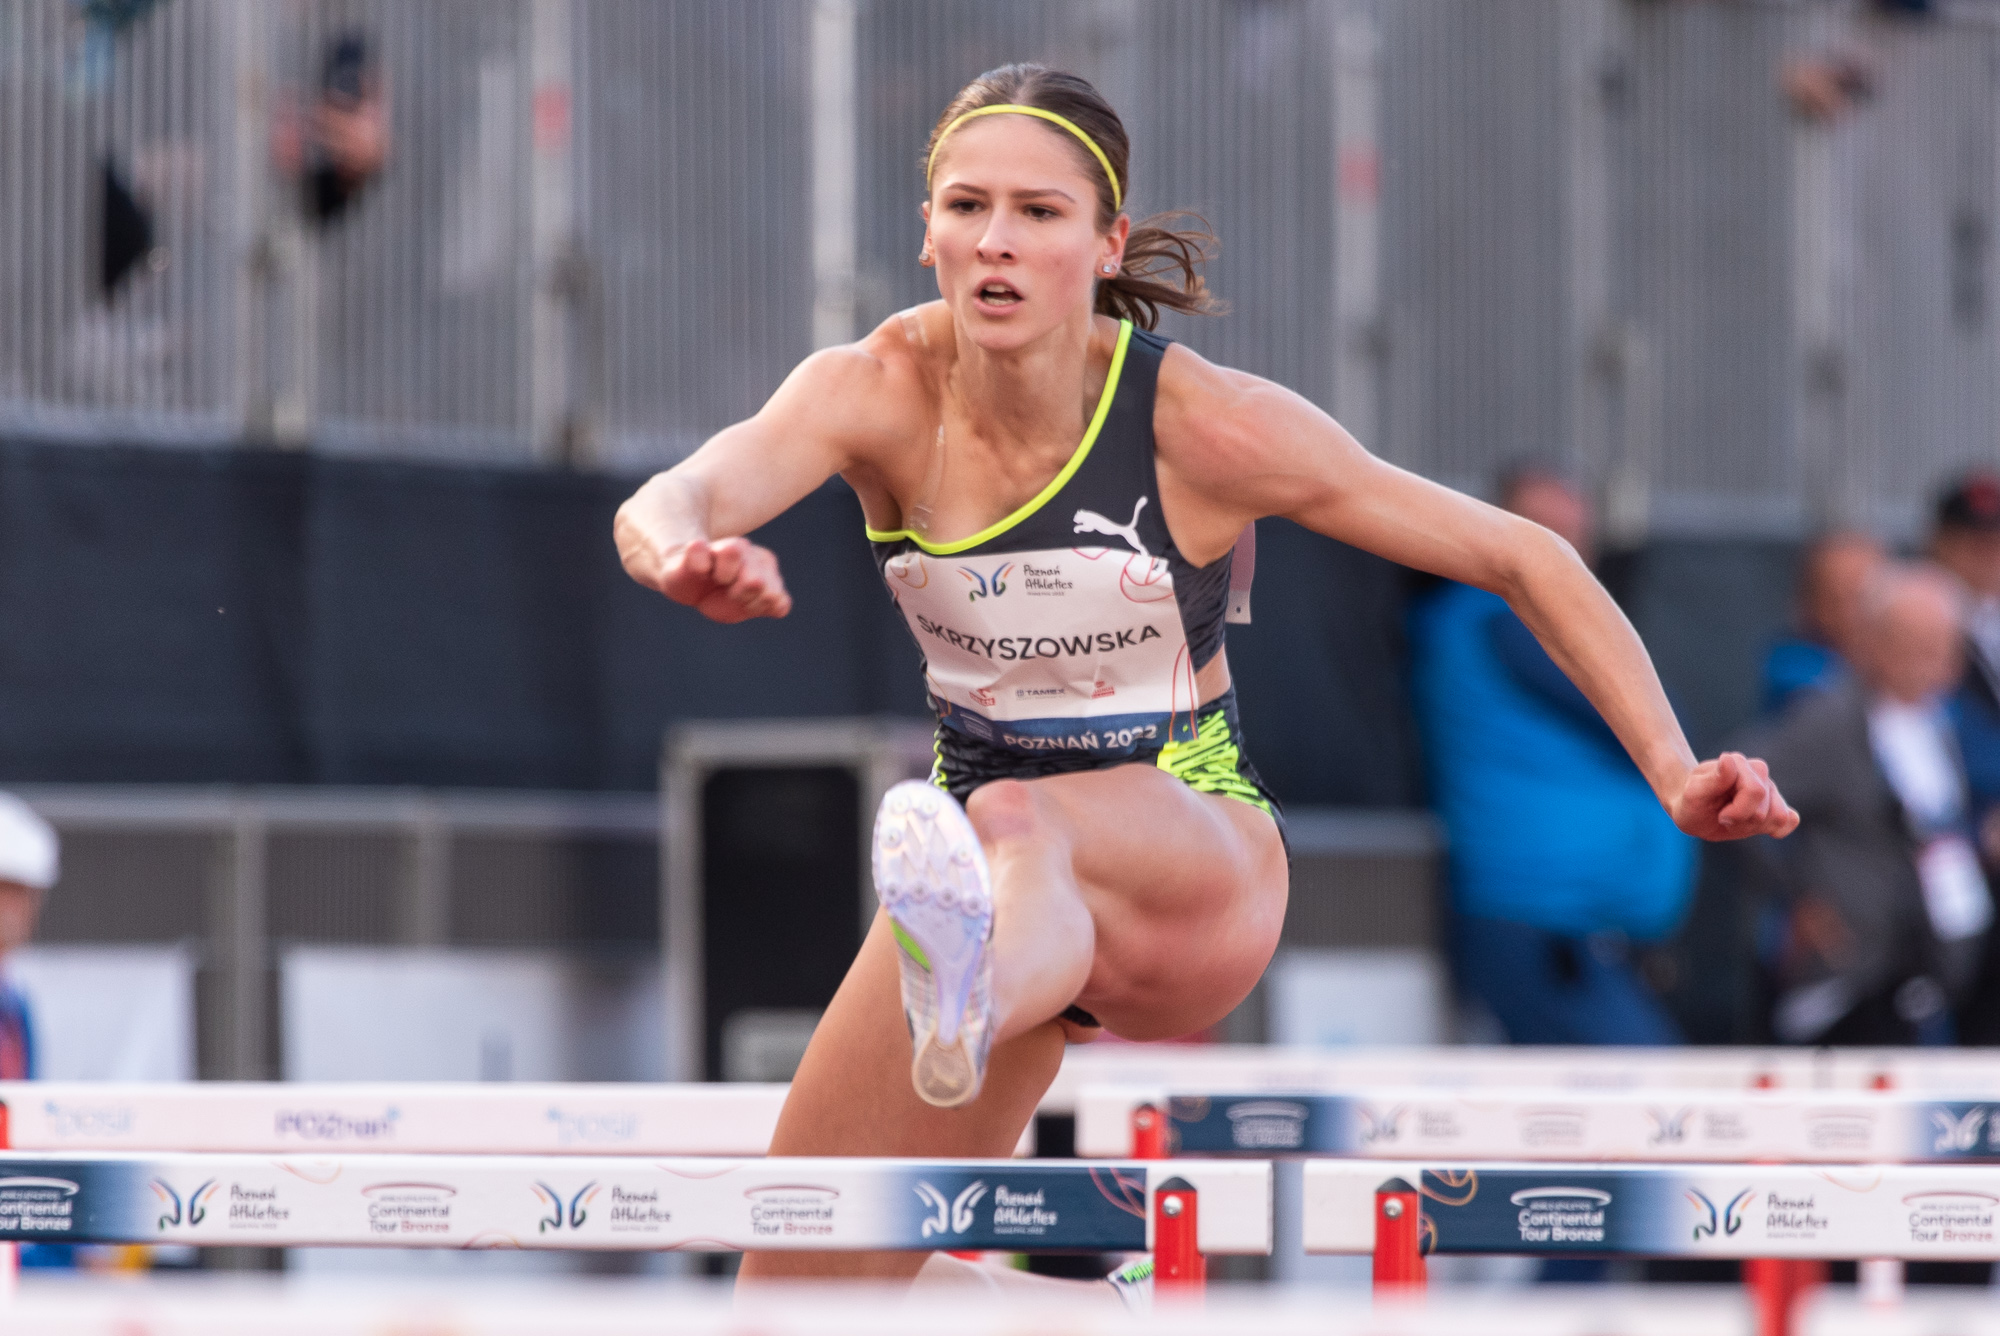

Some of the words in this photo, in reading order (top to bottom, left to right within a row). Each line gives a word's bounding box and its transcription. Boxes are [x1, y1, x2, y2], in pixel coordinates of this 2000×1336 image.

[1023, 564, 1061, 577] Poznań
[1025, 578, 1073, 590] Athletics
[916, 613, 1161, 661] SKRZYSZOWSKA
[1003, 730, 1100, 750] POZNAŃ
[0, 1200, 71, 1215] ontinental
[229, 1205, 290, 1220] Athletics
[368, 1204, 450, 1218] Continental
[610, 1207, 671, 1222] Athletics
[751, 1206, 833, 1221] Continental
[0, 1217, 18, 1231] our
[20, 1216, 71, 1231] Bronze
[994, 1207, 1057, 1225] Athletics
[1518, 1210, 1604, 1227] Continental
[1767, 1214, 1828, 1229] Athletics
[1908, 1212, 1993, 1227] Continental
[369, 1220, 398, 1233] Tour
[401, 1220, 450, 1233] Bronze
[752, 1223, 780, 1236] Tour
[784, 1223, 833, 1236] Bronze
[1519, 1227, 1551, 1242] Tour
[1553, 1227, 1604, 1242] Bronze
[1910, 1228, 1939, 1242] Tour
[1942, 1228, 1993, 1242] Bronze
